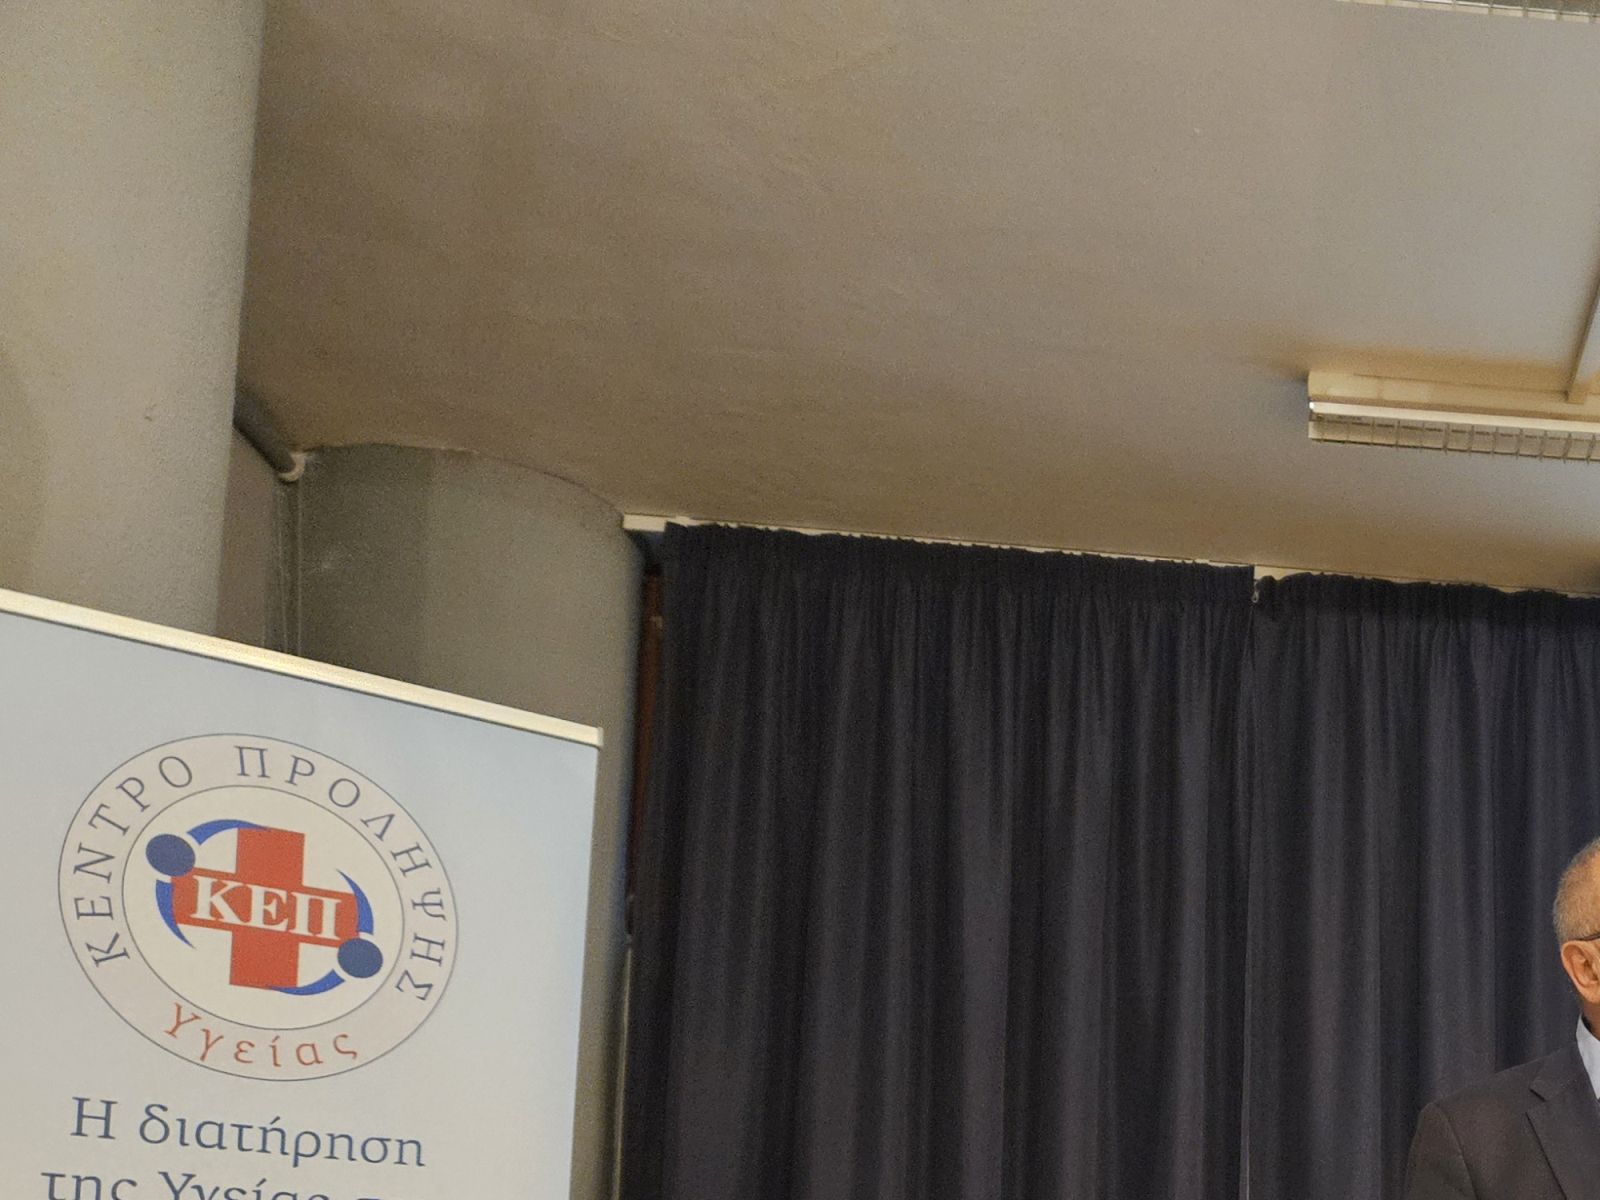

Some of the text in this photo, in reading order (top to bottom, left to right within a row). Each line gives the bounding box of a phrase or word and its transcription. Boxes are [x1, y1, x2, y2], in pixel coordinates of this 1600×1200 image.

[75, 745, 446, 1001] ΚΕΝΤΡΟ ΠΡΟΛΗΨΗΣ
[190, 875, 342, 941] ΚΕΠ
[164, 1002, 359, 1069] Υγείας
[70, 1096, 426, 1168] Η διατήρηση
